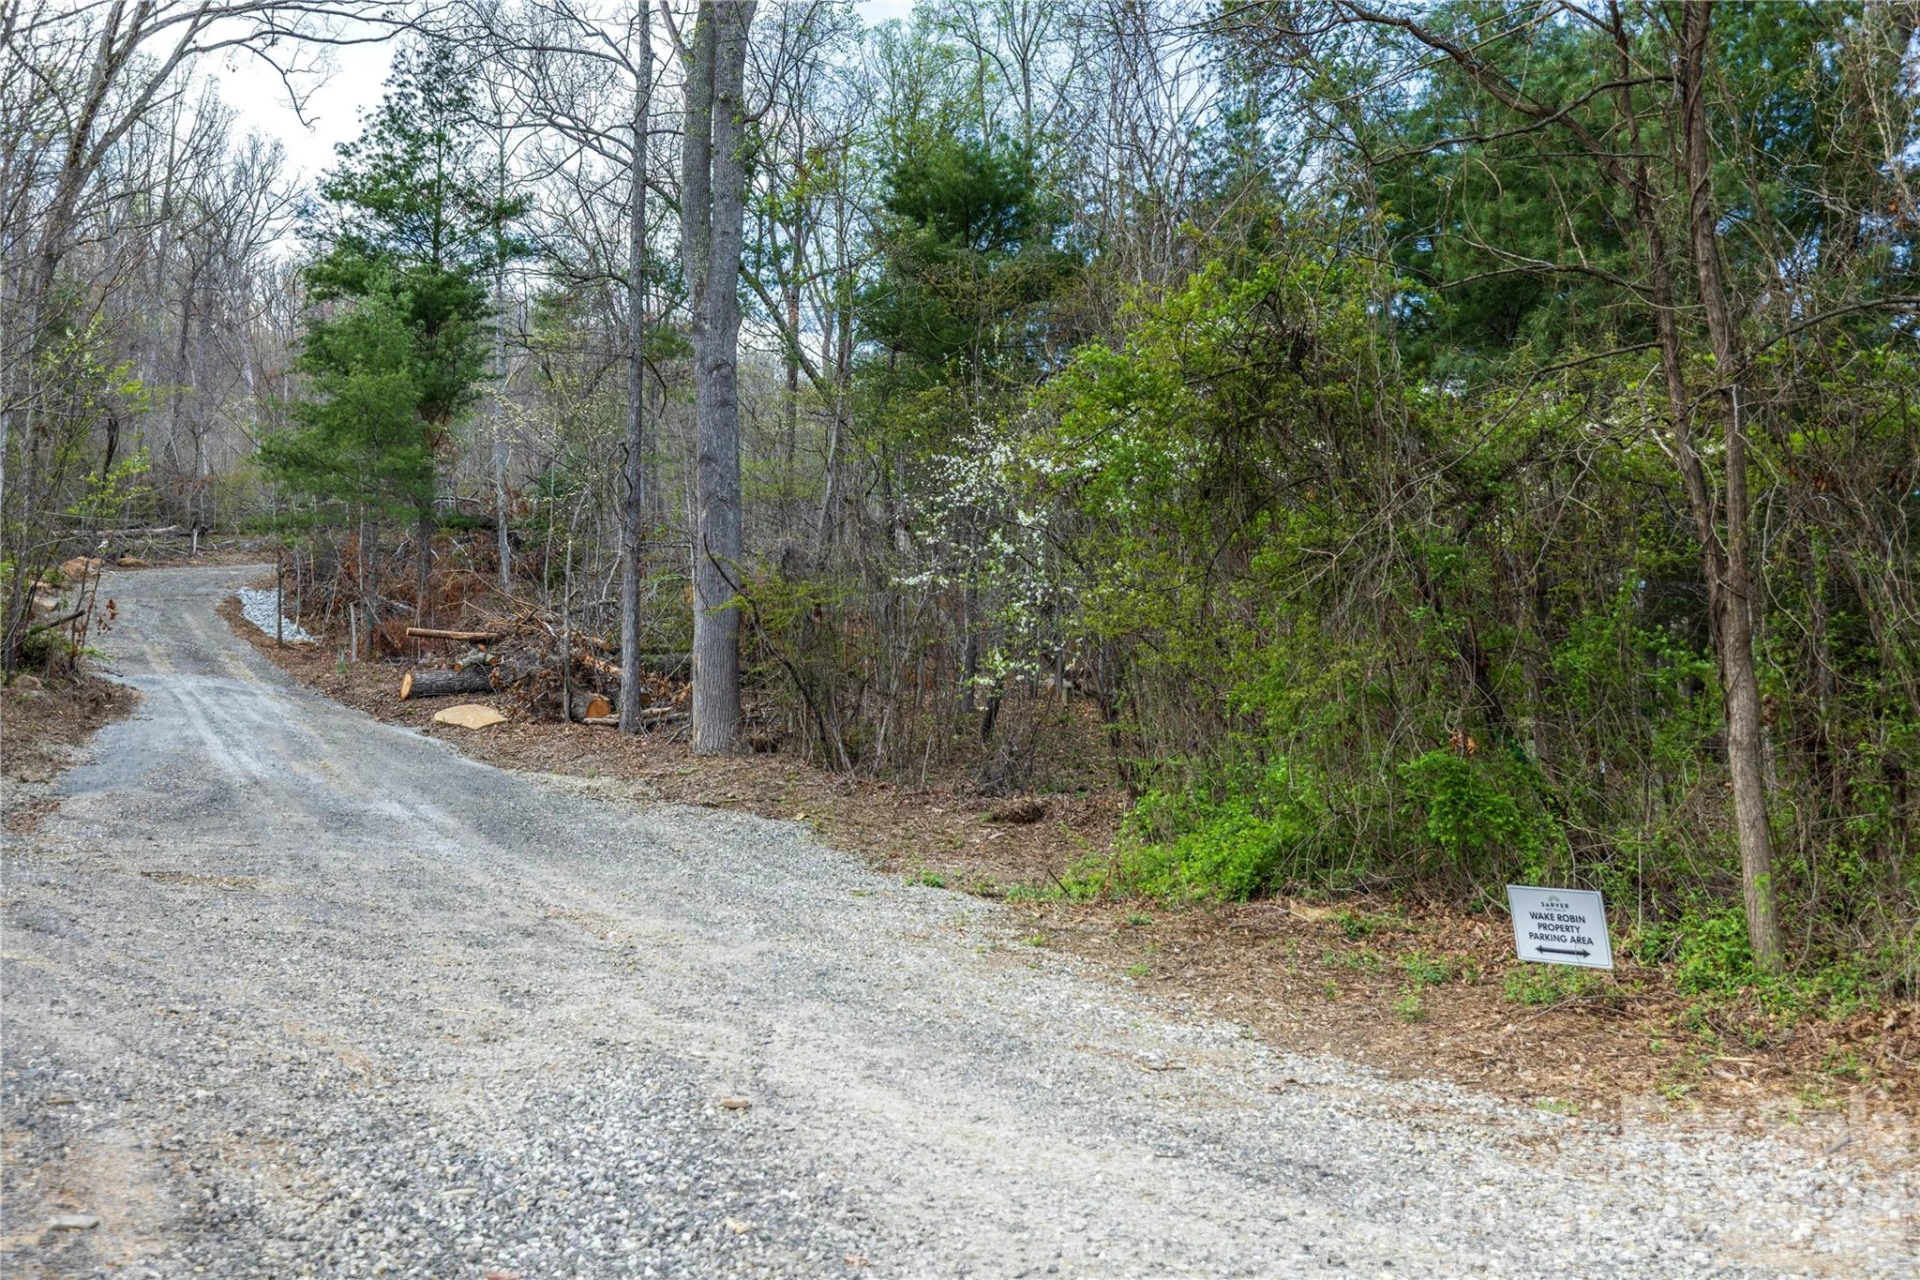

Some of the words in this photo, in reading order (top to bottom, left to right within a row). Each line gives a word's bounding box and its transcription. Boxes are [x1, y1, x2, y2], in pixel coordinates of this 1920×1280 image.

[1529, 911, 1555, 921] WAKE
[1557, 913, 1586, 923] ROBIN
[1537, 922, 1580, 934] PROPERTY
[1528, 932, 1568, 943] PARKING
[1570, 936, 1594, 946] AREA
